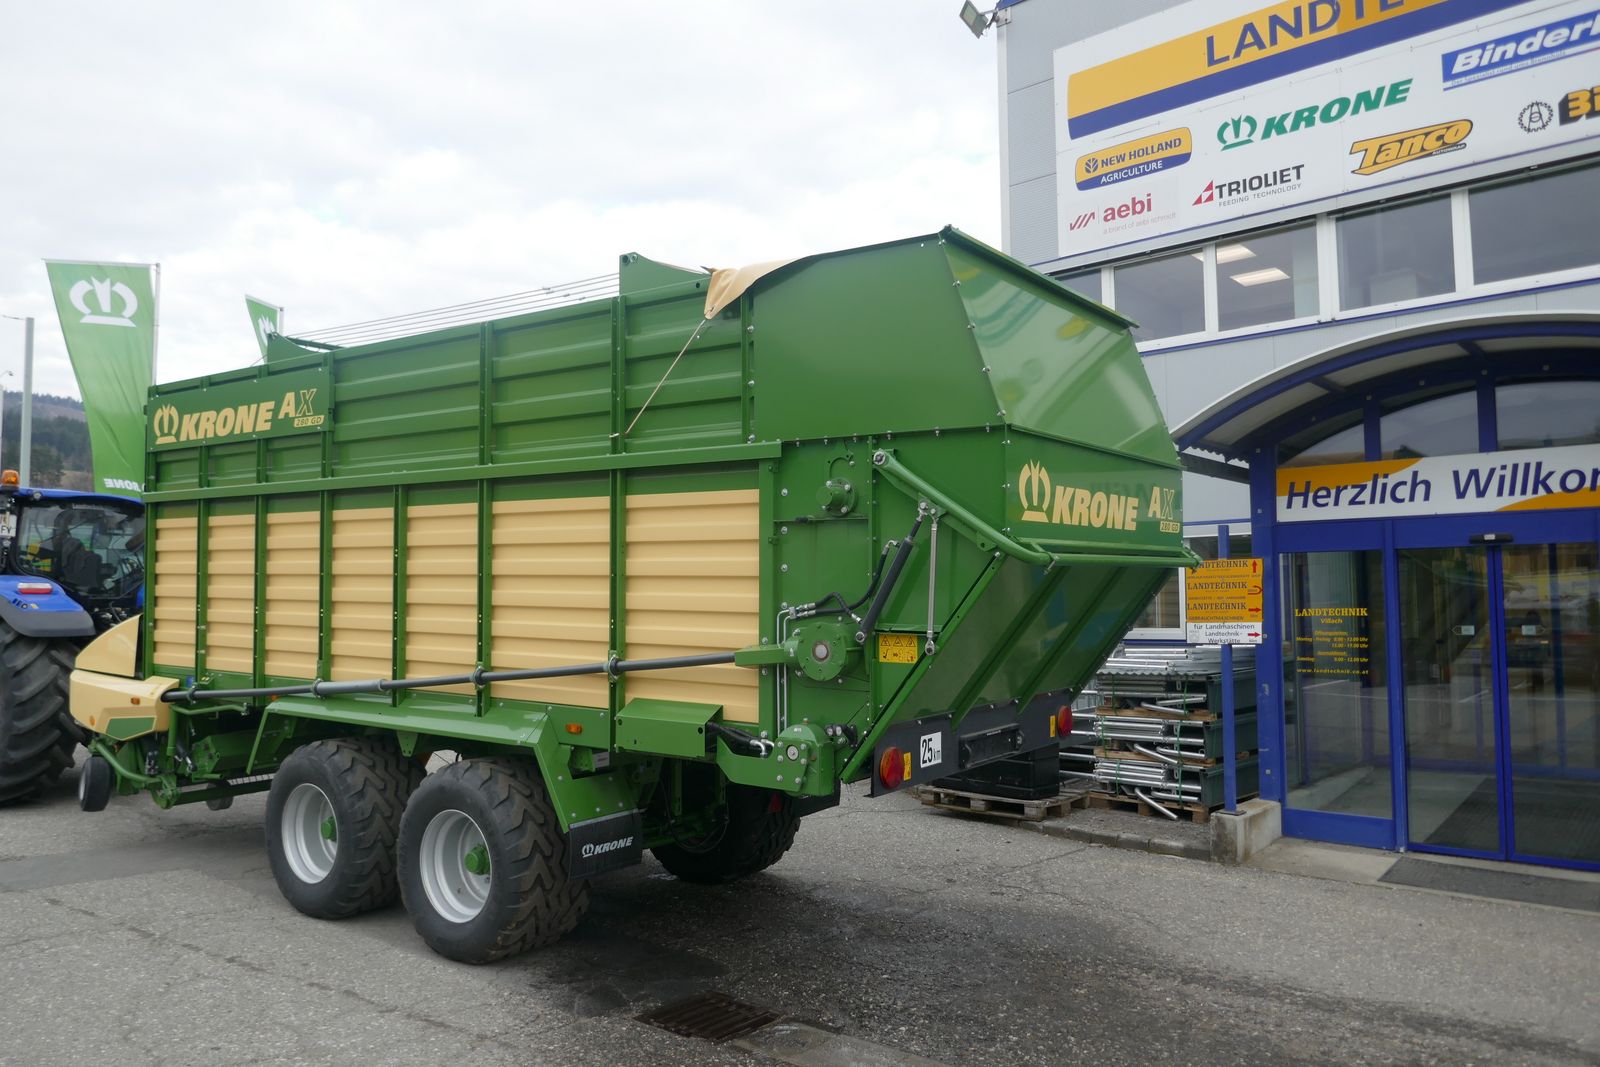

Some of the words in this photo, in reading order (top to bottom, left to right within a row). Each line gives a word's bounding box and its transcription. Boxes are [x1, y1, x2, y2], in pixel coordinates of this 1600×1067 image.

[1261, 78, 1413, 141] KRONE
[1101, 153, 1126, 168] NEW
[1128, 137, 1182, 161] HOLLAND
[1350, 119, 1471, 174] Tanco
[1100, 160, 1163, 184] AGRICULTURE
[1215, 164, 1305, 199] TRIOLIET
[1103, 193, 1152, 222] aebi
[1218, 195, 1250, 208] FEEDING
[1252, 183, 1302, 200] TECHNOLOGY
[179, 401, 276, 442] KRONE
[278, 388, 317, 419] AX
[1286, 470, 1432, 510] Herzlich
[1052, 485, 1139, 531] KRONE
[1147, 486, 1175, 520] AX
[1188, 581, 1248, 590] LANDTECHNIK
[1187, 602, 1247, 611] LANDTECHNIK
[1295, 607, 1368, 617] LANDTECHNIK
[922, 738, 933, 764] 25
[594, 836, 634, 855] KRONE
